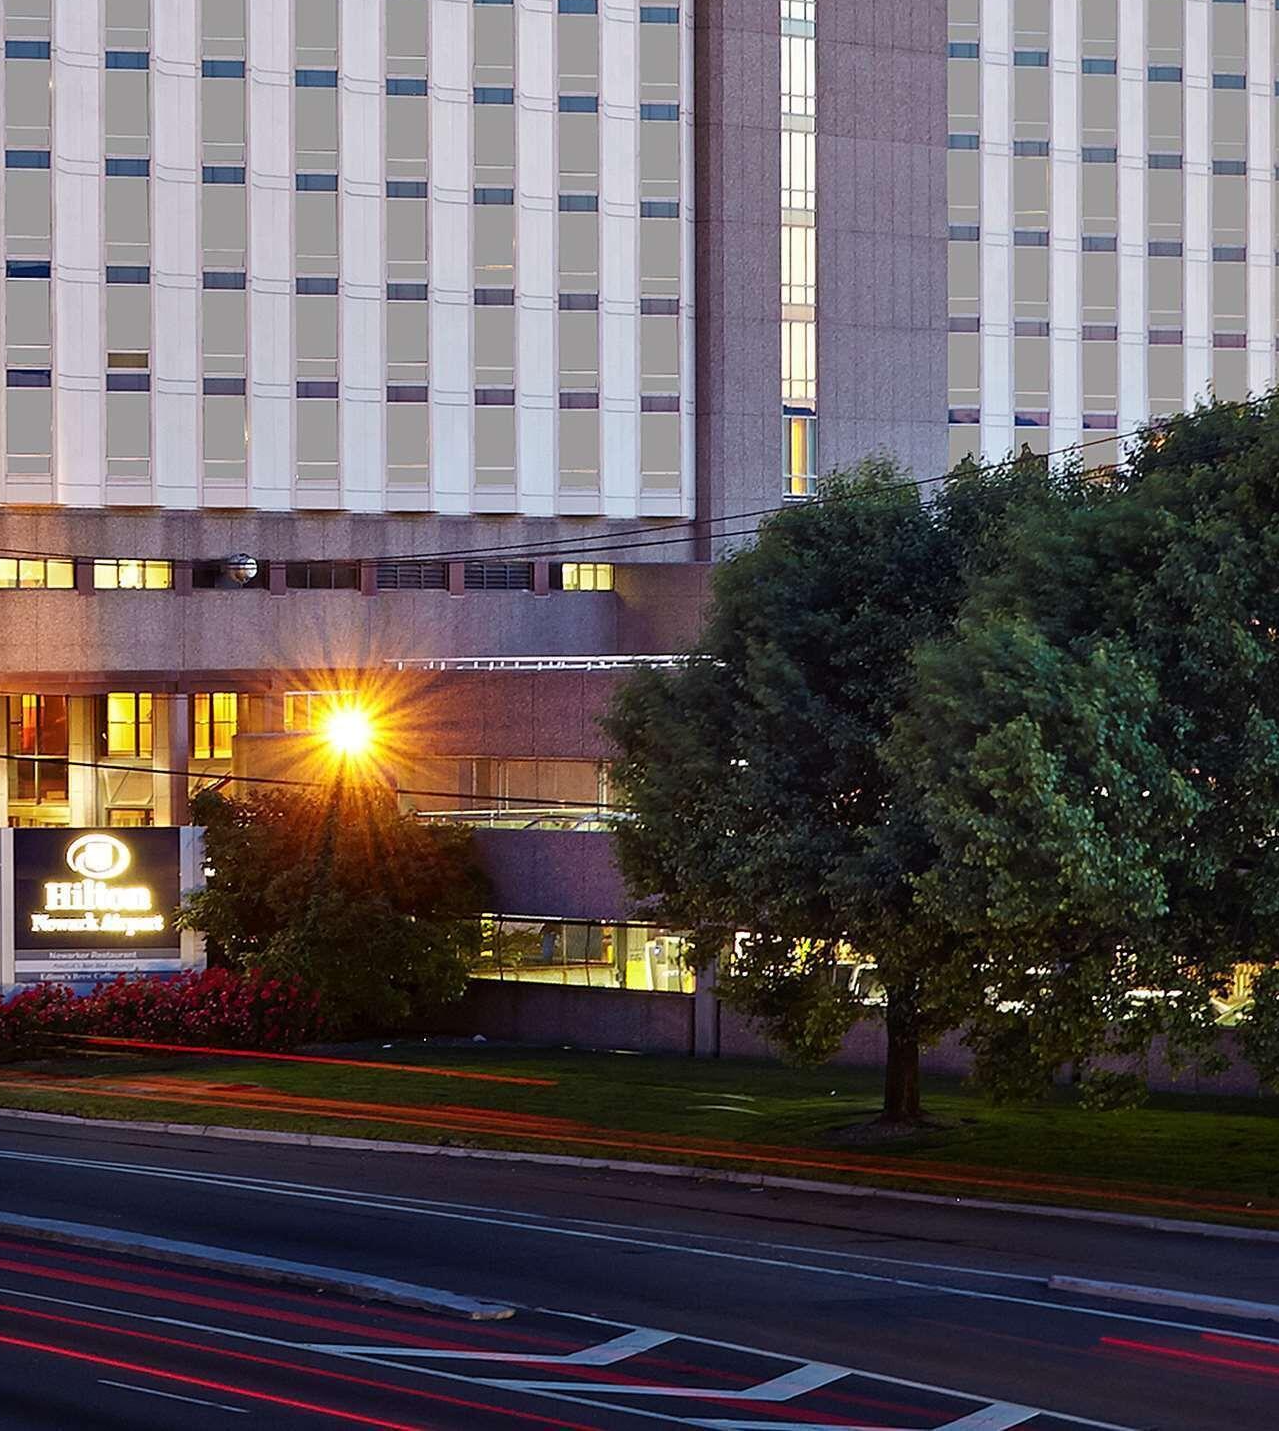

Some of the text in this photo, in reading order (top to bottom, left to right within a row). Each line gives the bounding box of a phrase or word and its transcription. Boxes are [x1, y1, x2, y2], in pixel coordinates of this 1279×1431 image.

[44, 878, 152, 910] Hilton
[31, 912, 164, 937] Newark Airport
[90, 951, 137, 960] Restaurant
